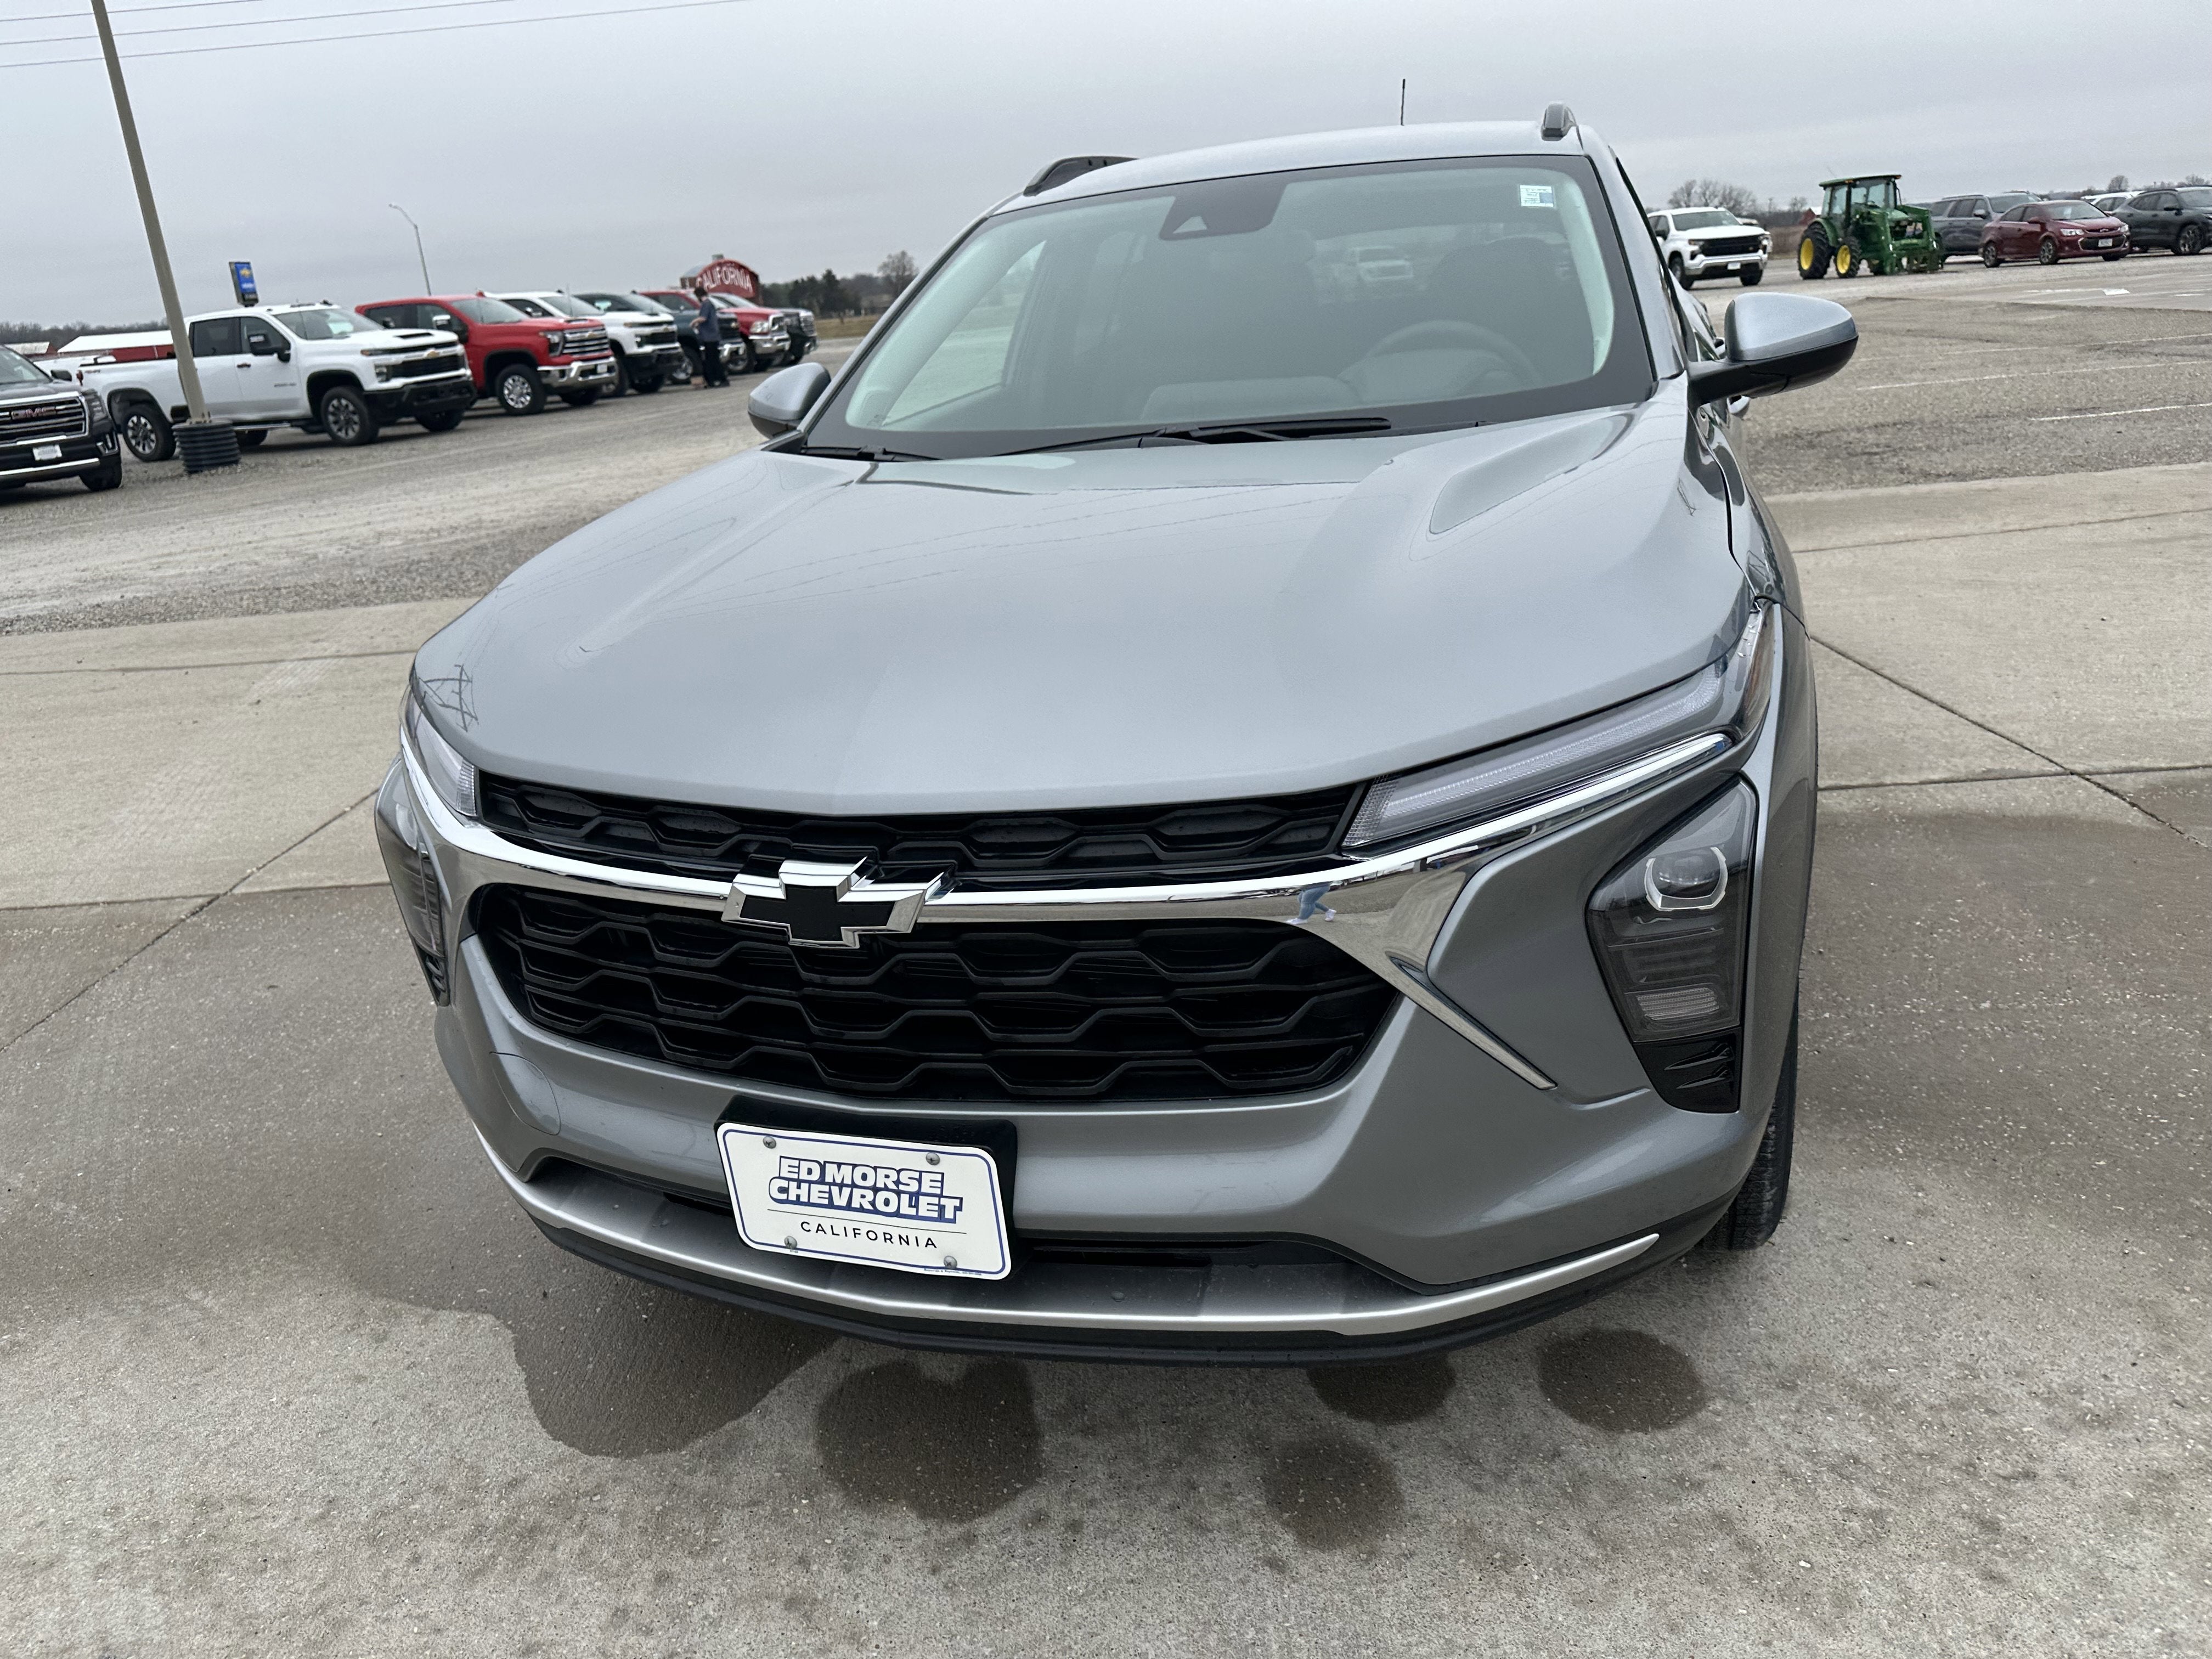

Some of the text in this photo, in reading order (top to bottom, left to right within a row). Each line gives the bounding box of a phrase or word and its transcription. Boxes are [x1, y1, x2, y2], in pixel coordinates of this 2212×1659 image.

[696, 266, 753, 294] CALIFORNIA
[11, 406, 57, 420] GMC
[779, 1156, 944, 1196] ED MORSE
[769, 1177, 963, 1224] CHEVROLET
[800, 1221, 937, 1249] CALIFORNIA
